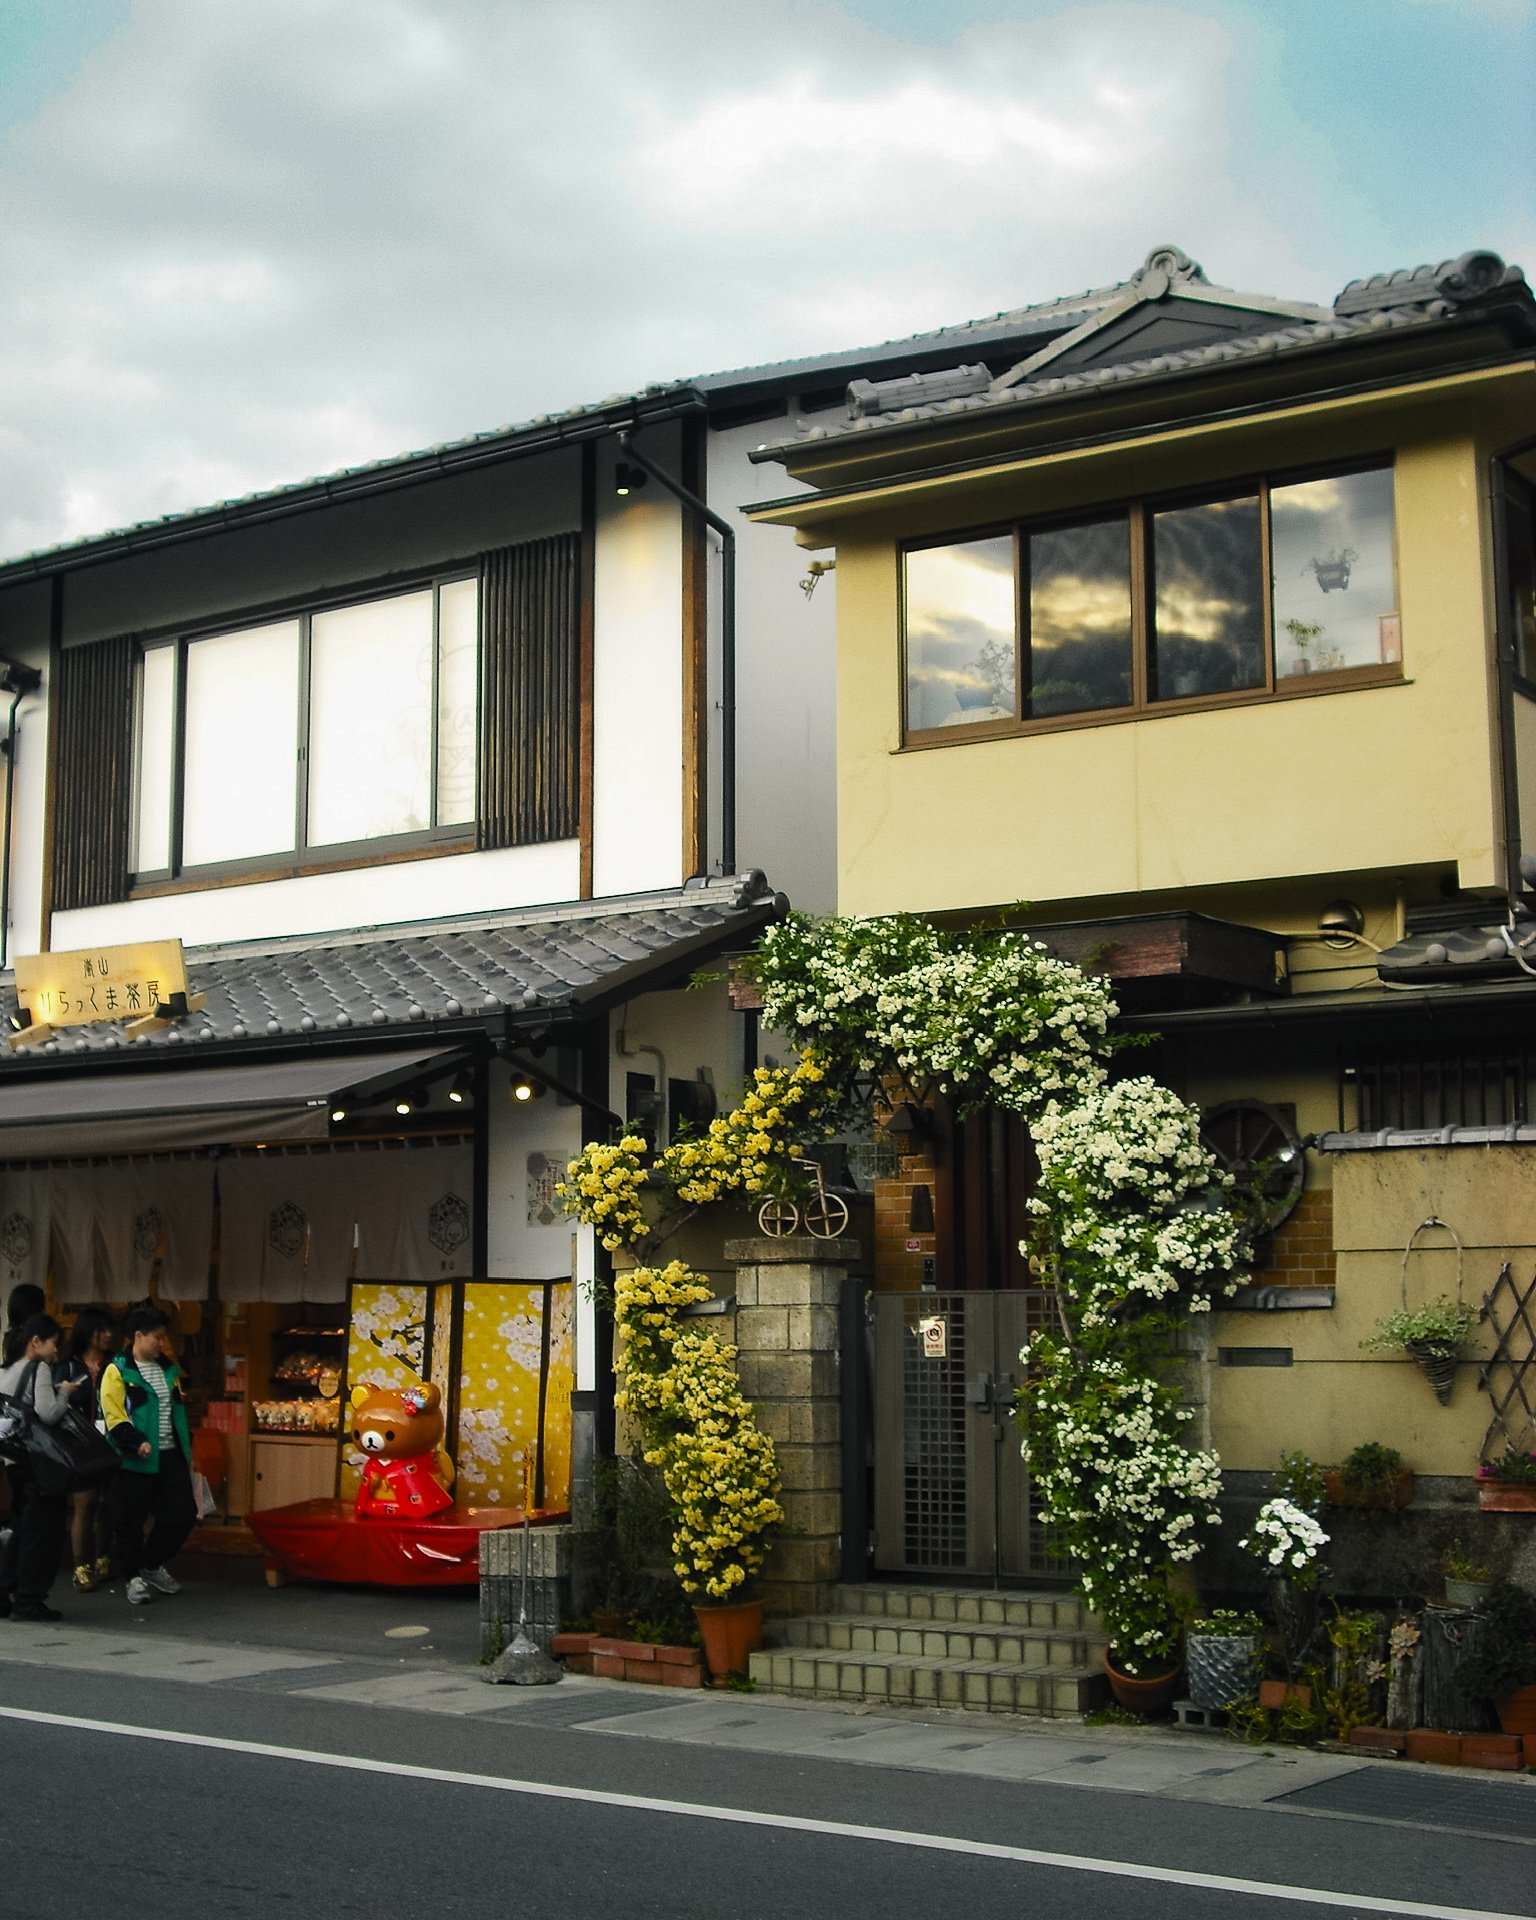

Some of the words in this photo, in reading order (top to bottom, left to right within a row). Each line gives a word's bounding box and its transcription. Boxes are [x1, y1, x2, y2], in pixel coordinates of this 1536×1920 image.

[40, 980, 160, 1014] りらっくま茶房
